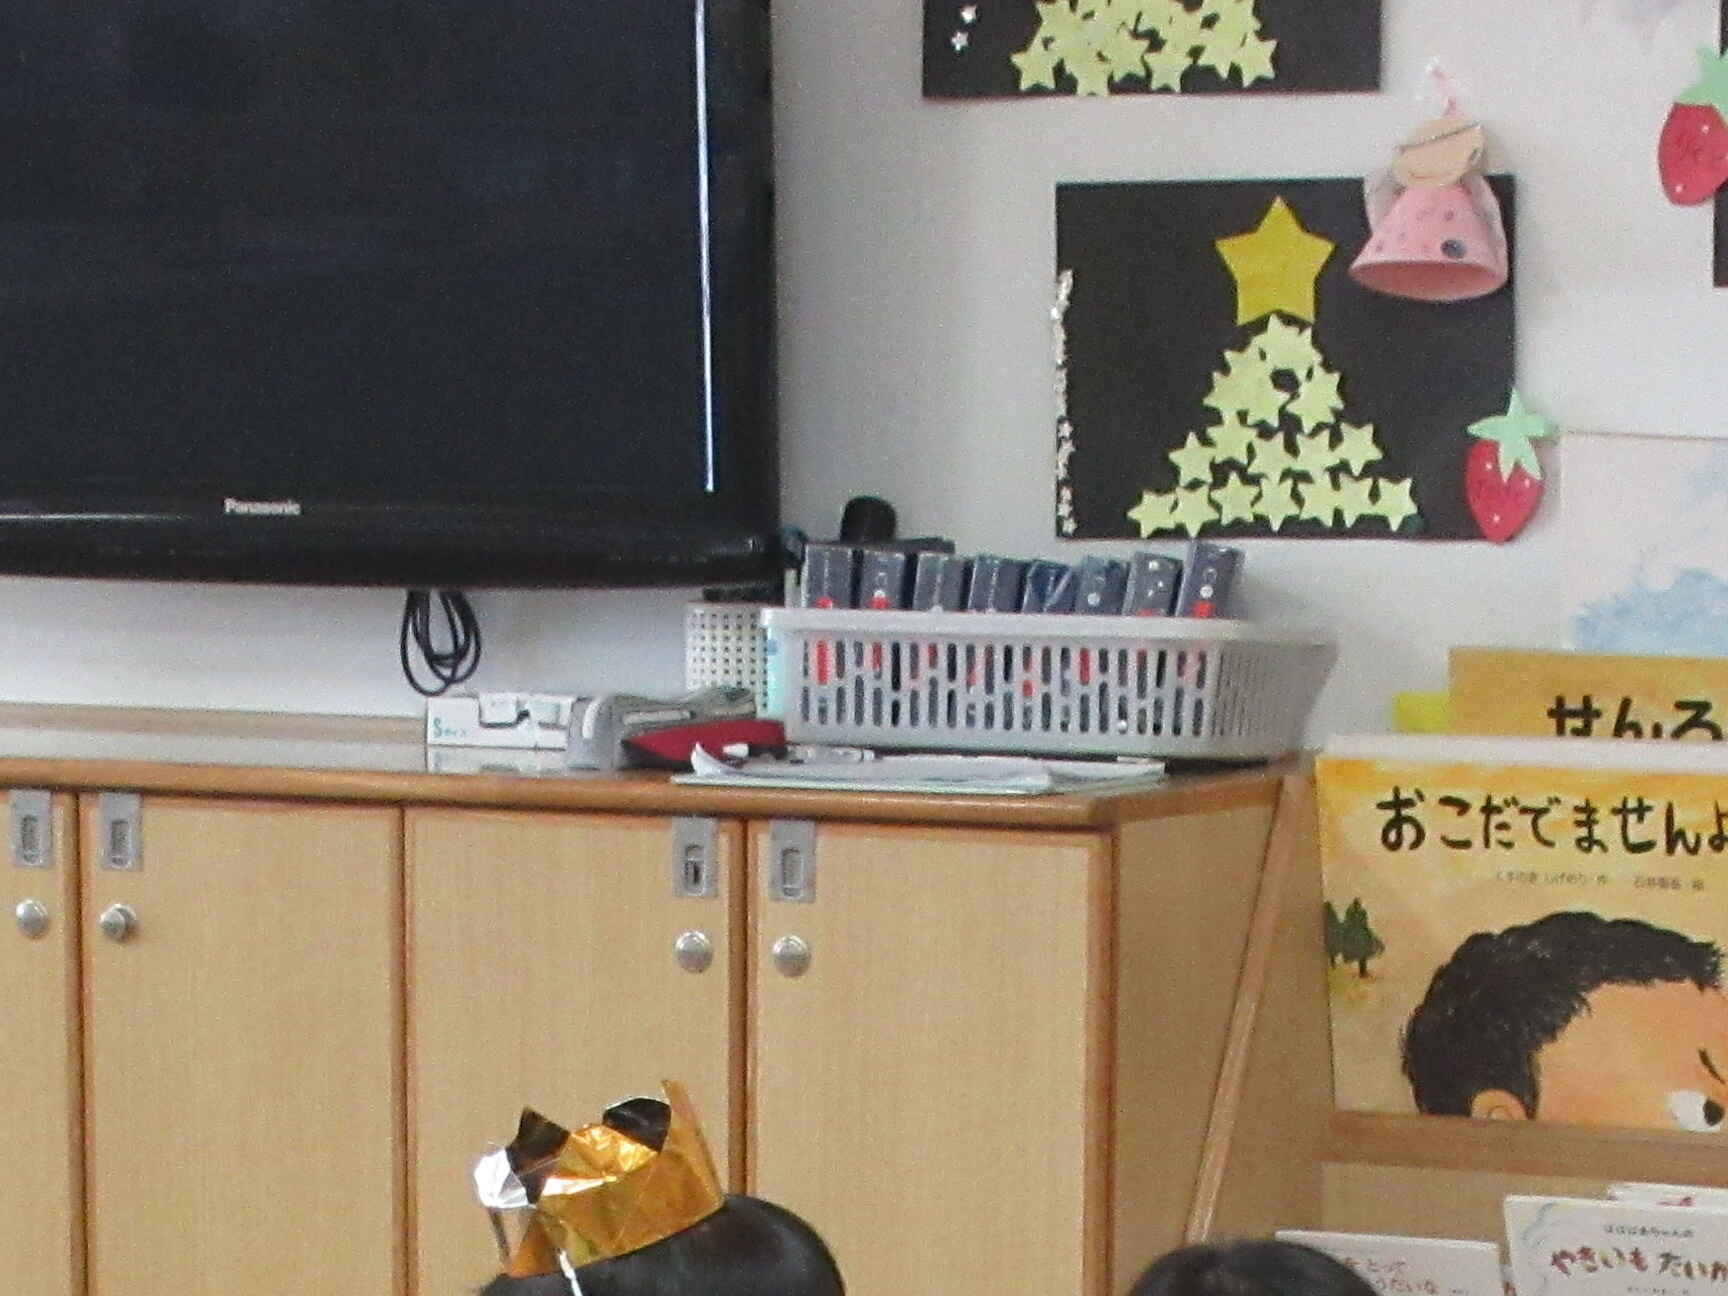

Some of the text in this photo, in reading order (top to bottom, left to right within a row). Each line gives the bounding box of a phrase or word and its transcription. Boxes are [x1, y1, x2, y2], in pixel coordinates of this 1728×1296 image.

[224, 498, 302, 515] Panasonic
[1549, 1245, 1650, 1276] やきいも
